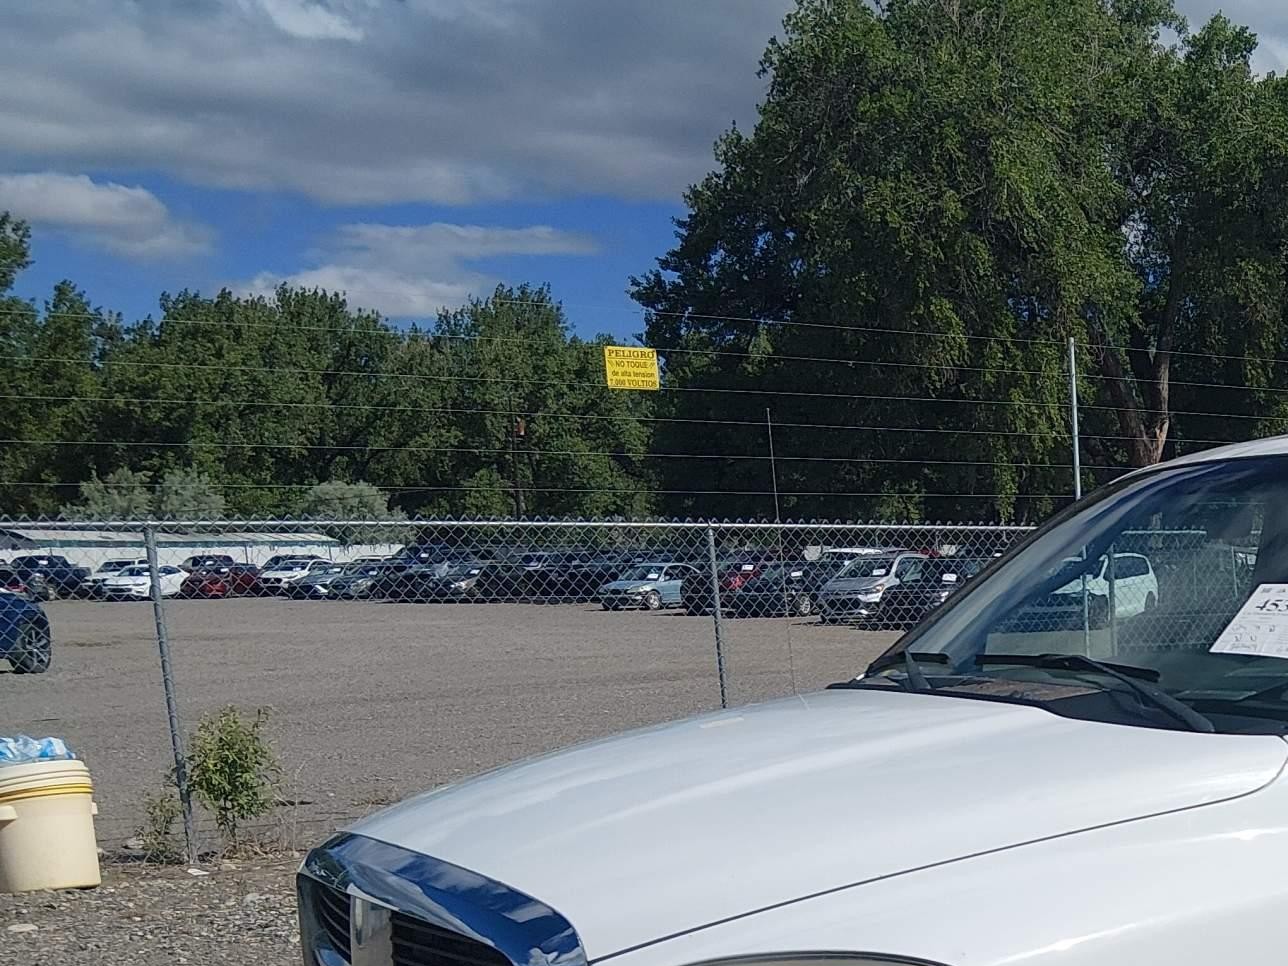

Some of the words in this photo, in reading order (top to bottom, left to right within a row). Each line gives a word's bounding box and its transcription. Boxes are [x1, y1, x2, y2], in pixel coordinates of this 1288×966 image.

[608, 349, 655, 359] PELIGRO
[615, 360, 625, 368] NO
[626, 361, 649, 369] TOQUE
[627, 379, 657, 387] VOLTIOS
